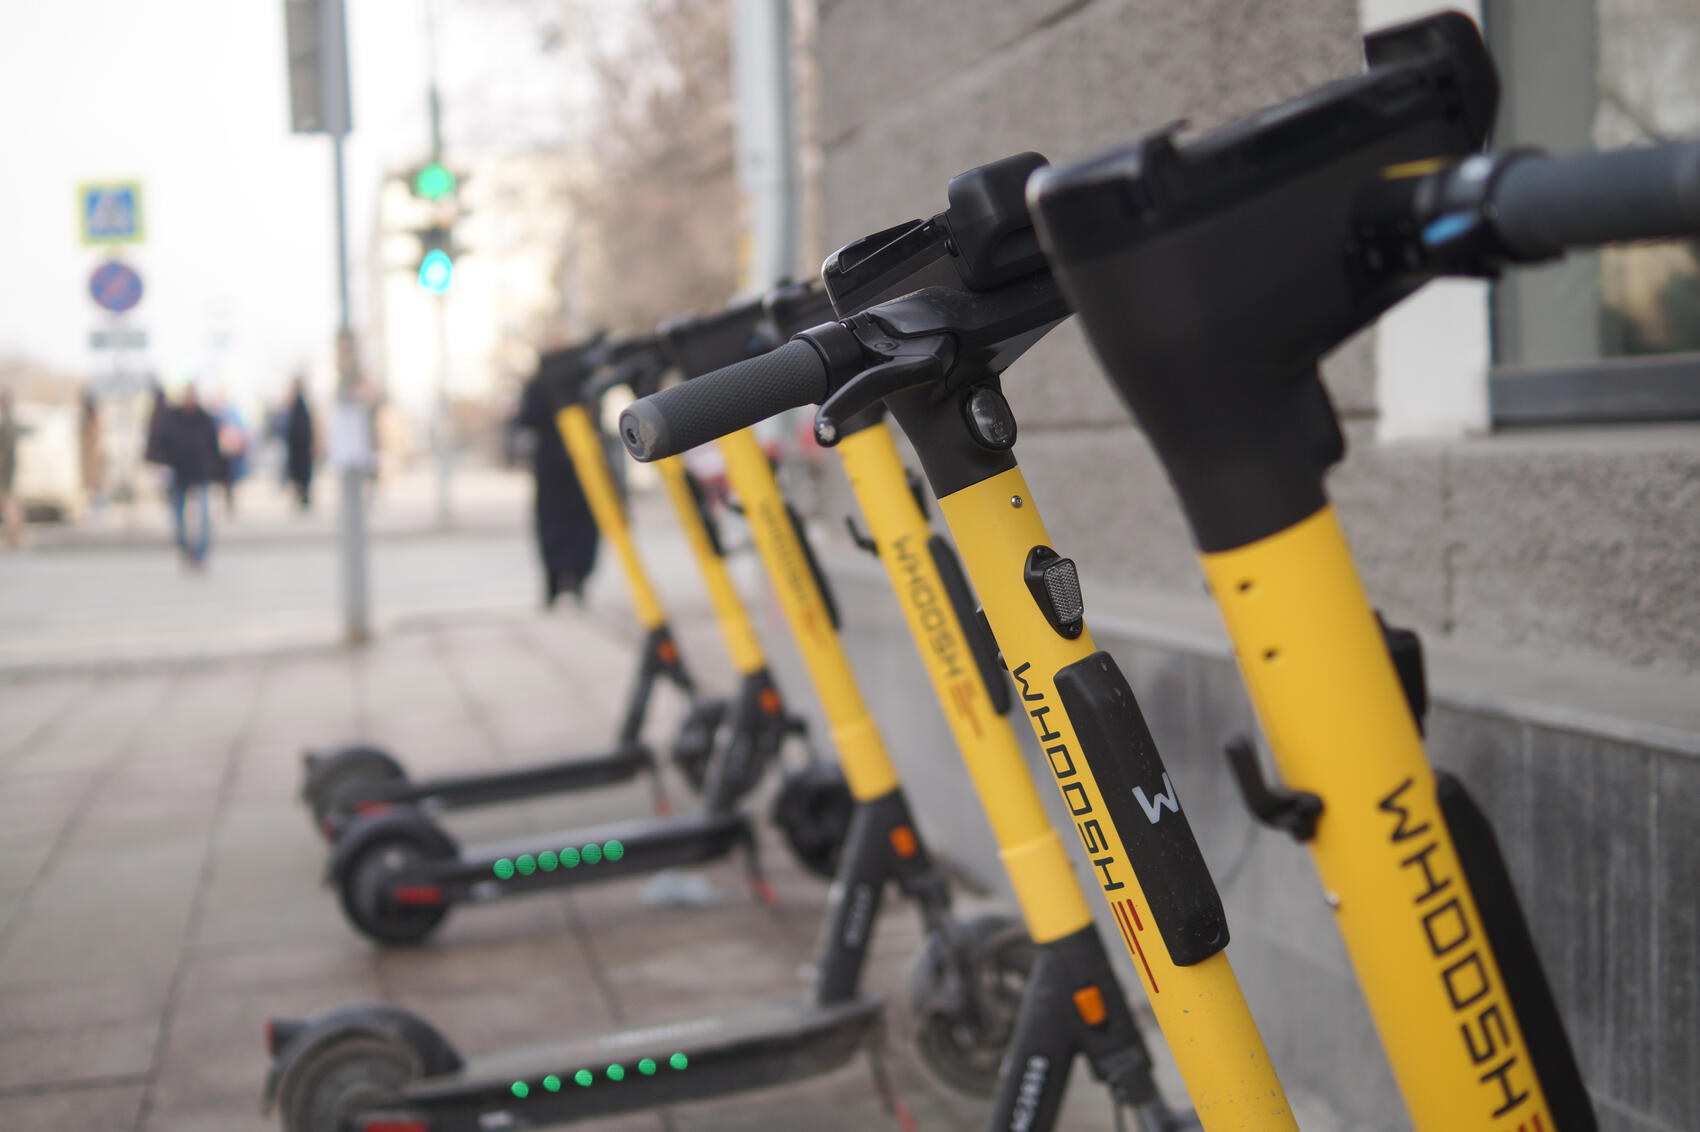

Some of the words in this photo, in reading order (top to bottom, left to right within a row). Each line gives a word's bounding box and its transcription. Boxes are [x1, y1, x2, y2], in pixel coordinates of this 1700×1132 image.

[892, 534, 965, 679] WHOOSH
[1012, 661, 1125, 891] WHOOSH
[1131, 771, 1179, 824] W
[1376, 777, 1530, 1119] WHOOSH
